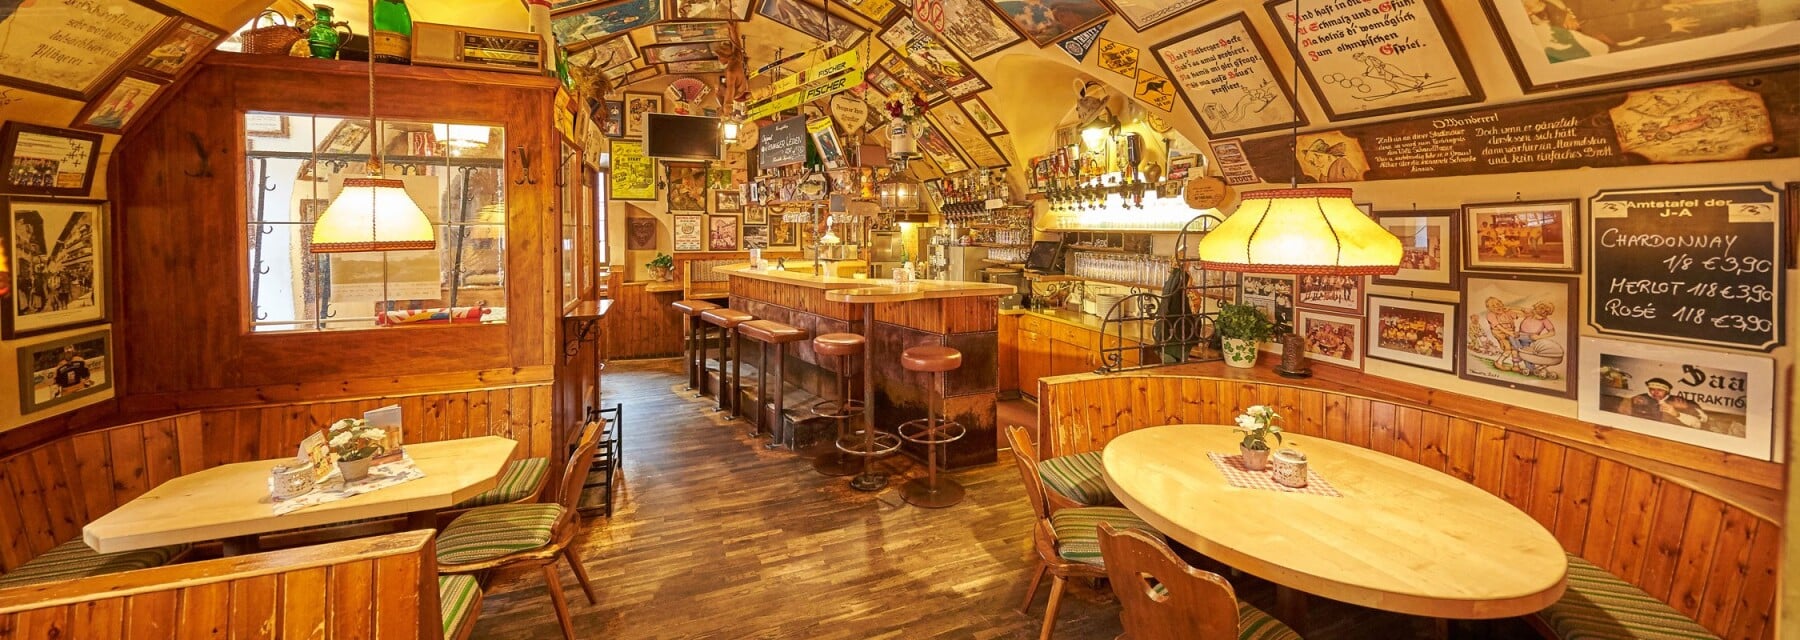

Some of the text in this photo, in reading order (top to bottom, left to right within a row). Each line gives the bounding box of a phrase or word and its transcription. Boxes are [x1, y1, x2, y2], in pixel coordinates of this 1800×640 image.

[1308, 14, 1351, 32] Schmalz
[1351, 9, 1370, 21] und
[1360, 9, 1416, 33] womöglich
[1101, 42, 1116, 53] LAST
[1336, 31, 1399, 53] olympischen
[818, 61, 847, 77] FISCHER
[806, 77, 847, 100] FISCHER
[1475, 127, 1498, 137] Doch
[1487, 156, 1509, 166] und
[1627, 199, 1732, 210] Amtstafel der
[1660, 208, 1693, 218] J-A
[1601, 228, 1738, 257] CHARDONNAY
[1663, 253, 1694, 274] 1/8
[1609, 277, 1685, 296] MERLOT
[1687, 282, 1718, 298] 1/8
[1605, 298, 1656, 319] ROSÉ
[1672, 306, 1705, 325] 1/8
